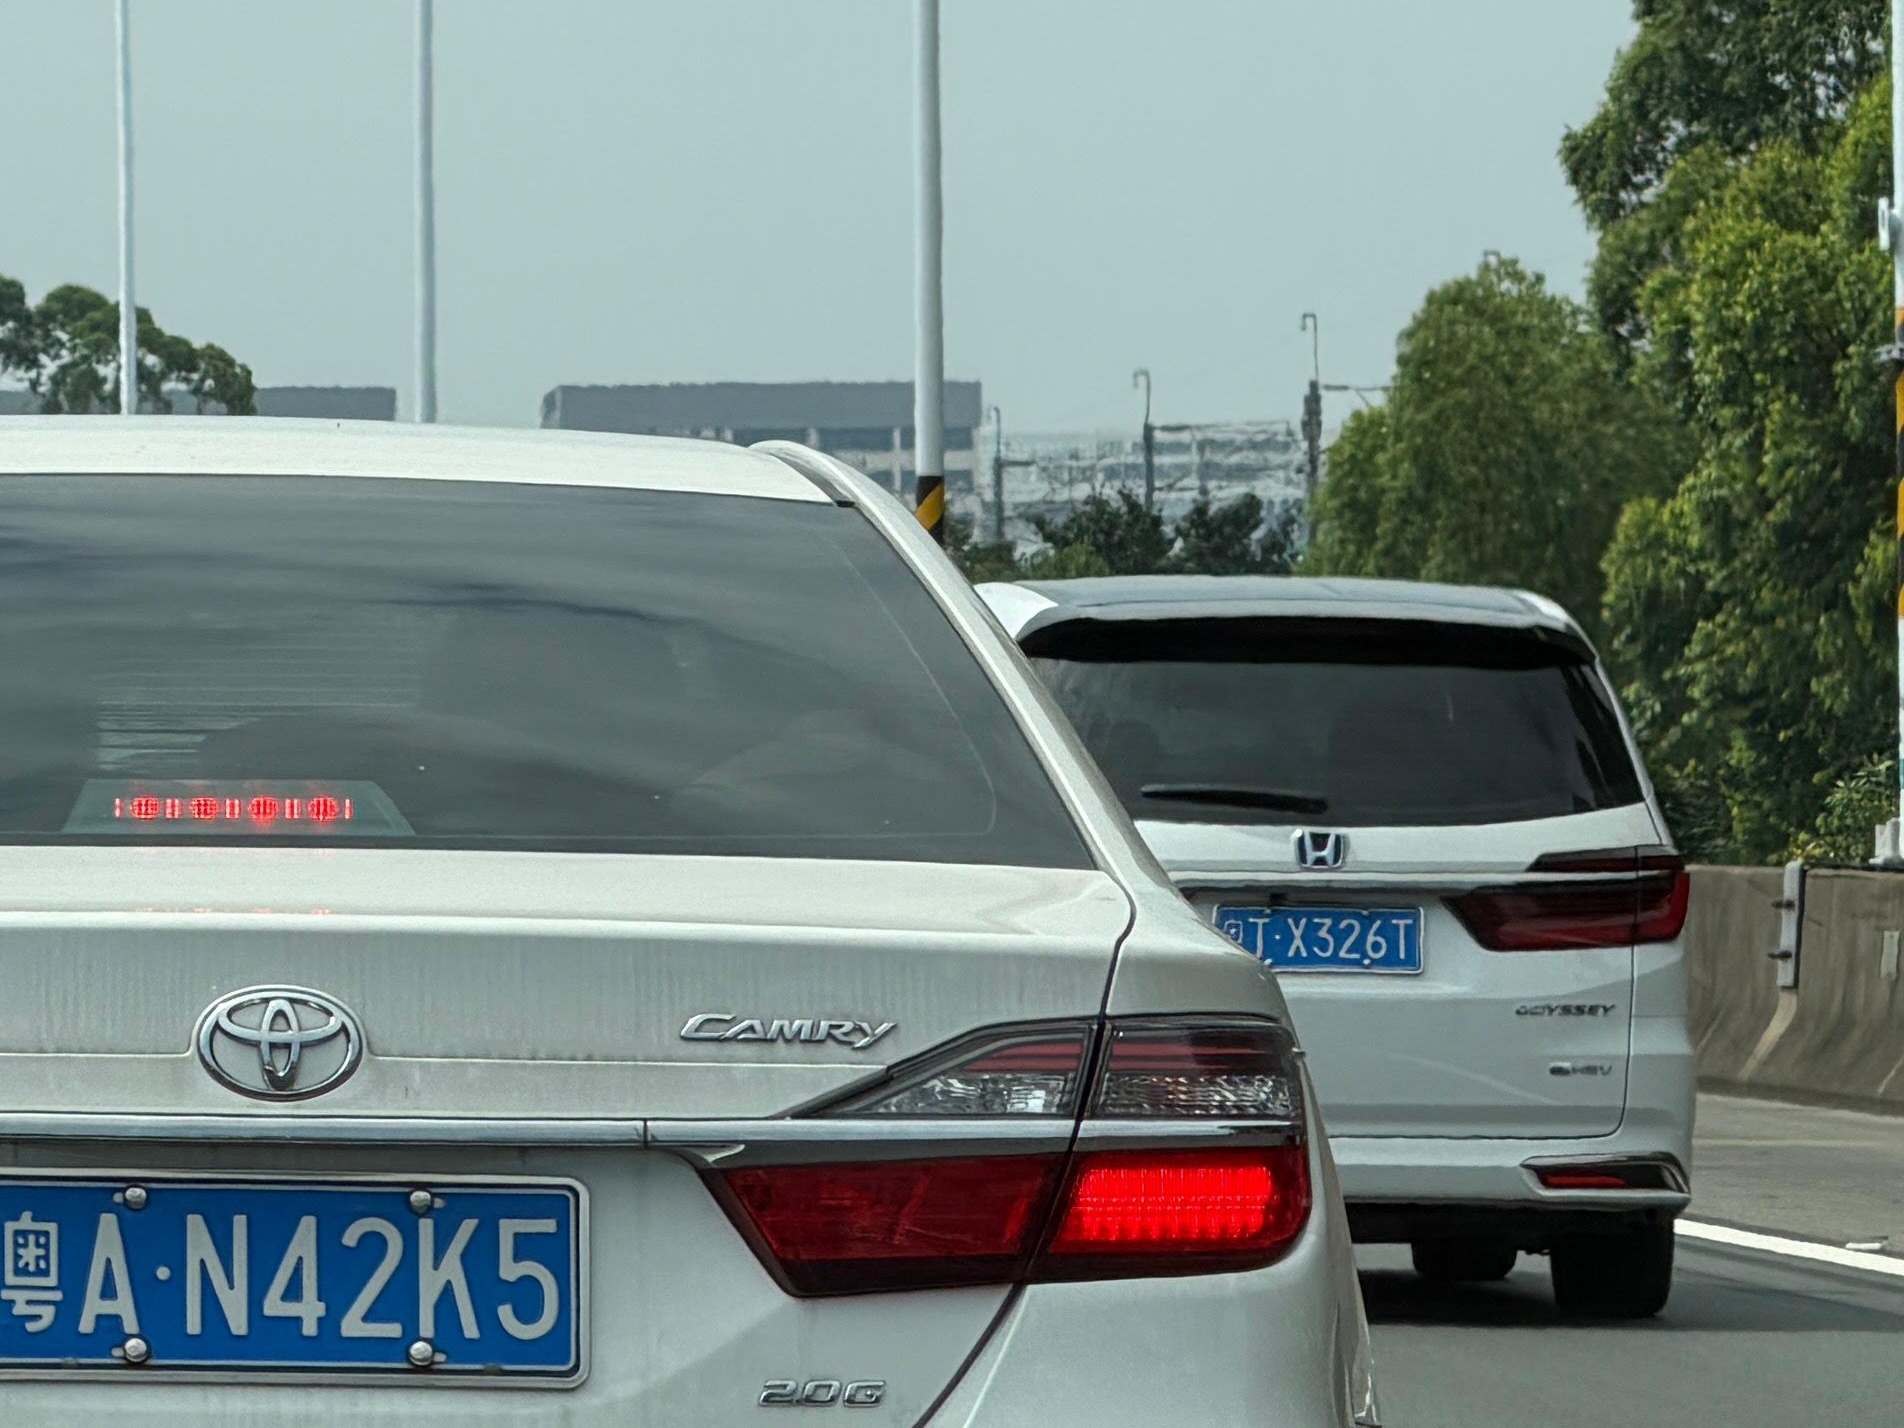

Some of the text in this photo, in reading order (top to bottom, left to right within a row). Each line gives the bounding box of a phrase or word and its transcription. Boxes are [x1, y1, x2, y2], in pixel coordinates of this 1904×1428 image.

[680, 1013, 896, 1049] CAMRY
[0, 1209, 560, 1341] 粤A·N42K5
[758, 1379, 887, 1408] 2.0G
